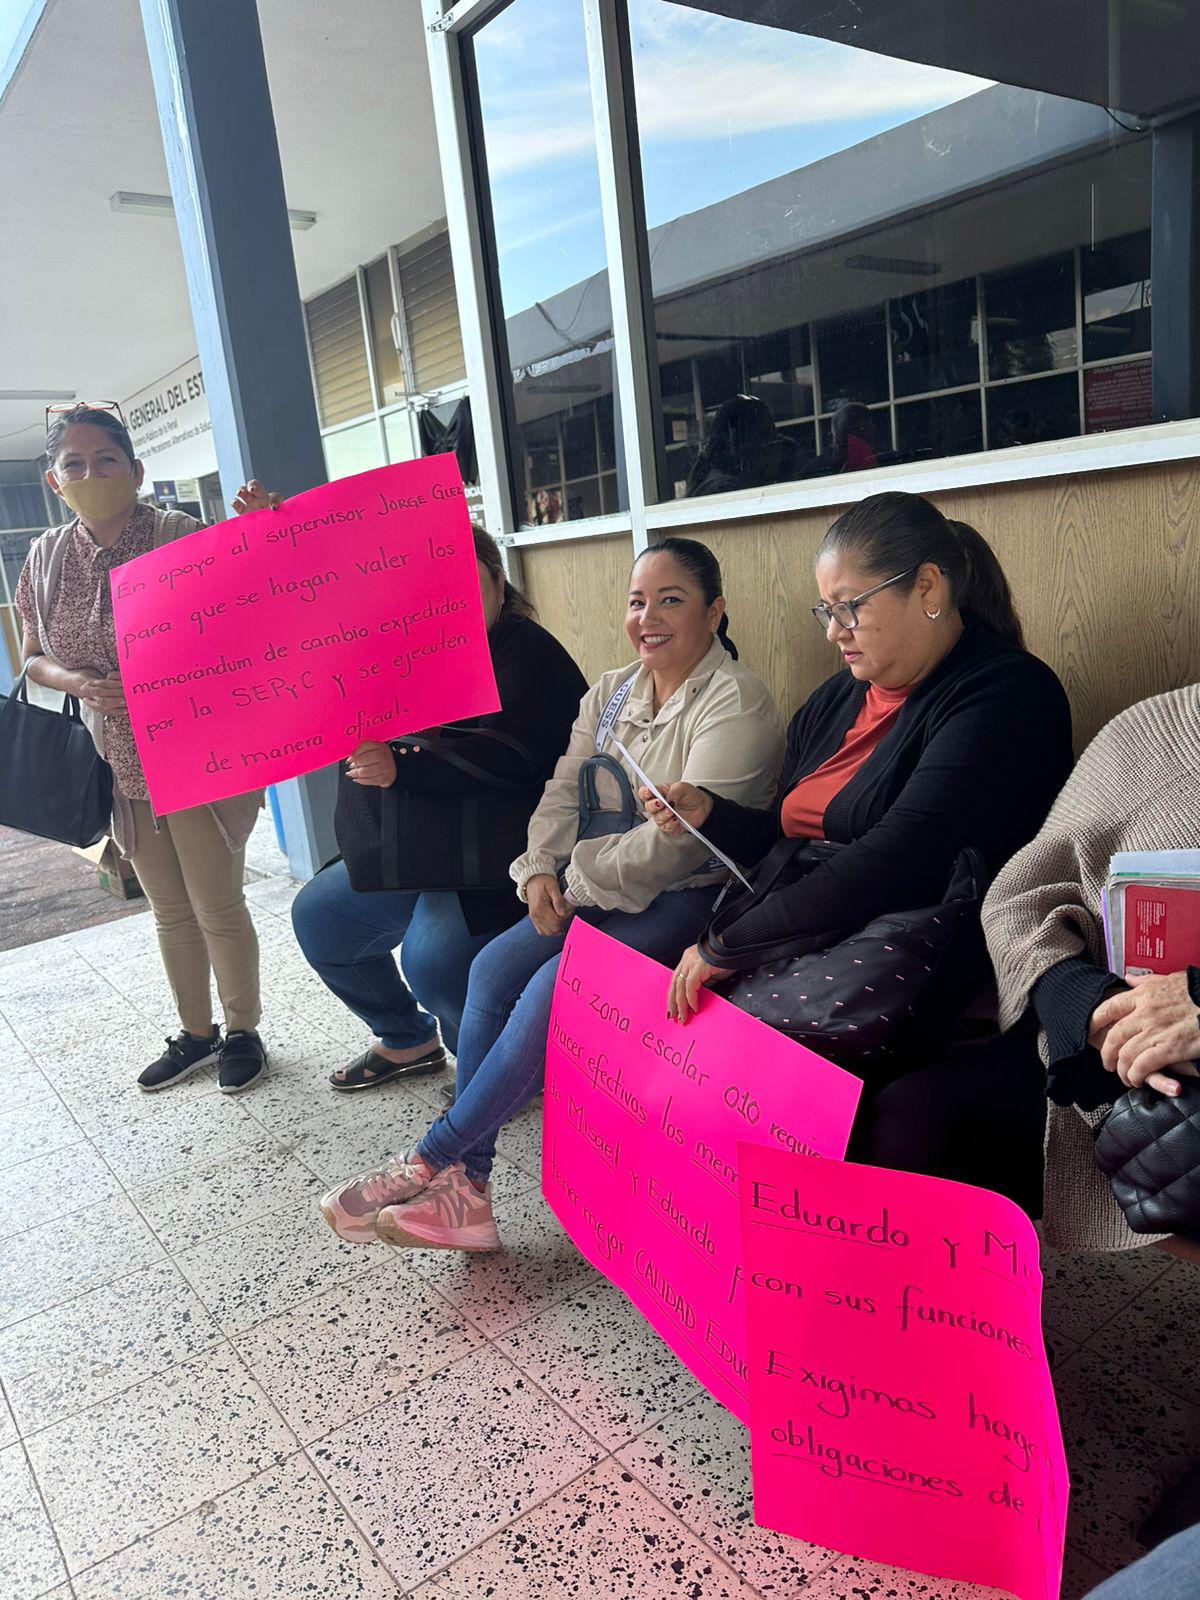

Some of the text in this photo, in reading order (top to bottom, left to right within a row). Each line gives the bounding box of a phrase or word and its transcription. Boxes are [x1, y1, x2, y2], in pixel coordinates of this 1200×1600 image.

[129, 394, 168, 430] GENERAL
[167, 384, 187, 410] DEL
[116, 581, 145, 599] En
[158, 555, 216, 591] apoyo
[231, 533, 250, 556] al
[266, 508, 366, 547] supervisor
[122, 537, 456, 658] para que se hagan valer los
[132, 597, 468, 695] memorándum de cambio expedidos
[146, 717, 175, 741] por
[188, 696, 212, 720] la
[358, 660, 381, 681] se
[393, 628, 468, 678] ejecuten
[205, 696, 410, 774] de manera oficial.
[602, 683, 629, 729] GUESS
[553, 1013, 585, 1059] hacer
[588, 1053, 648, 1121] efectivos
[662, 1095, 685, 1146] los
[560, 944, 582, 996] La
[590, 993, 630, 1034] zona
[641, 1031, 709, 1087] escolar
[724, 1085, 760, 1125] 010
[549, 1072, 561, 1104] de
[568, 1096, 620, 1167] Misael
[646, 1176, 716, 1256] Eduardo
[552, 1136, 581, 1206] tener
[583, 1206, 626, 1261] mejor
[635, 1249, 697, 1330] CALIDAD
[752, 1181, 909, 1248] Eduardo
[751, 1271, 803, 1299] con
[824, 1289, 876, 1314] sus
[765, 1350, 936, 1419] Exigimos
[770, 1420, 1026, 1515] obligaciones de
